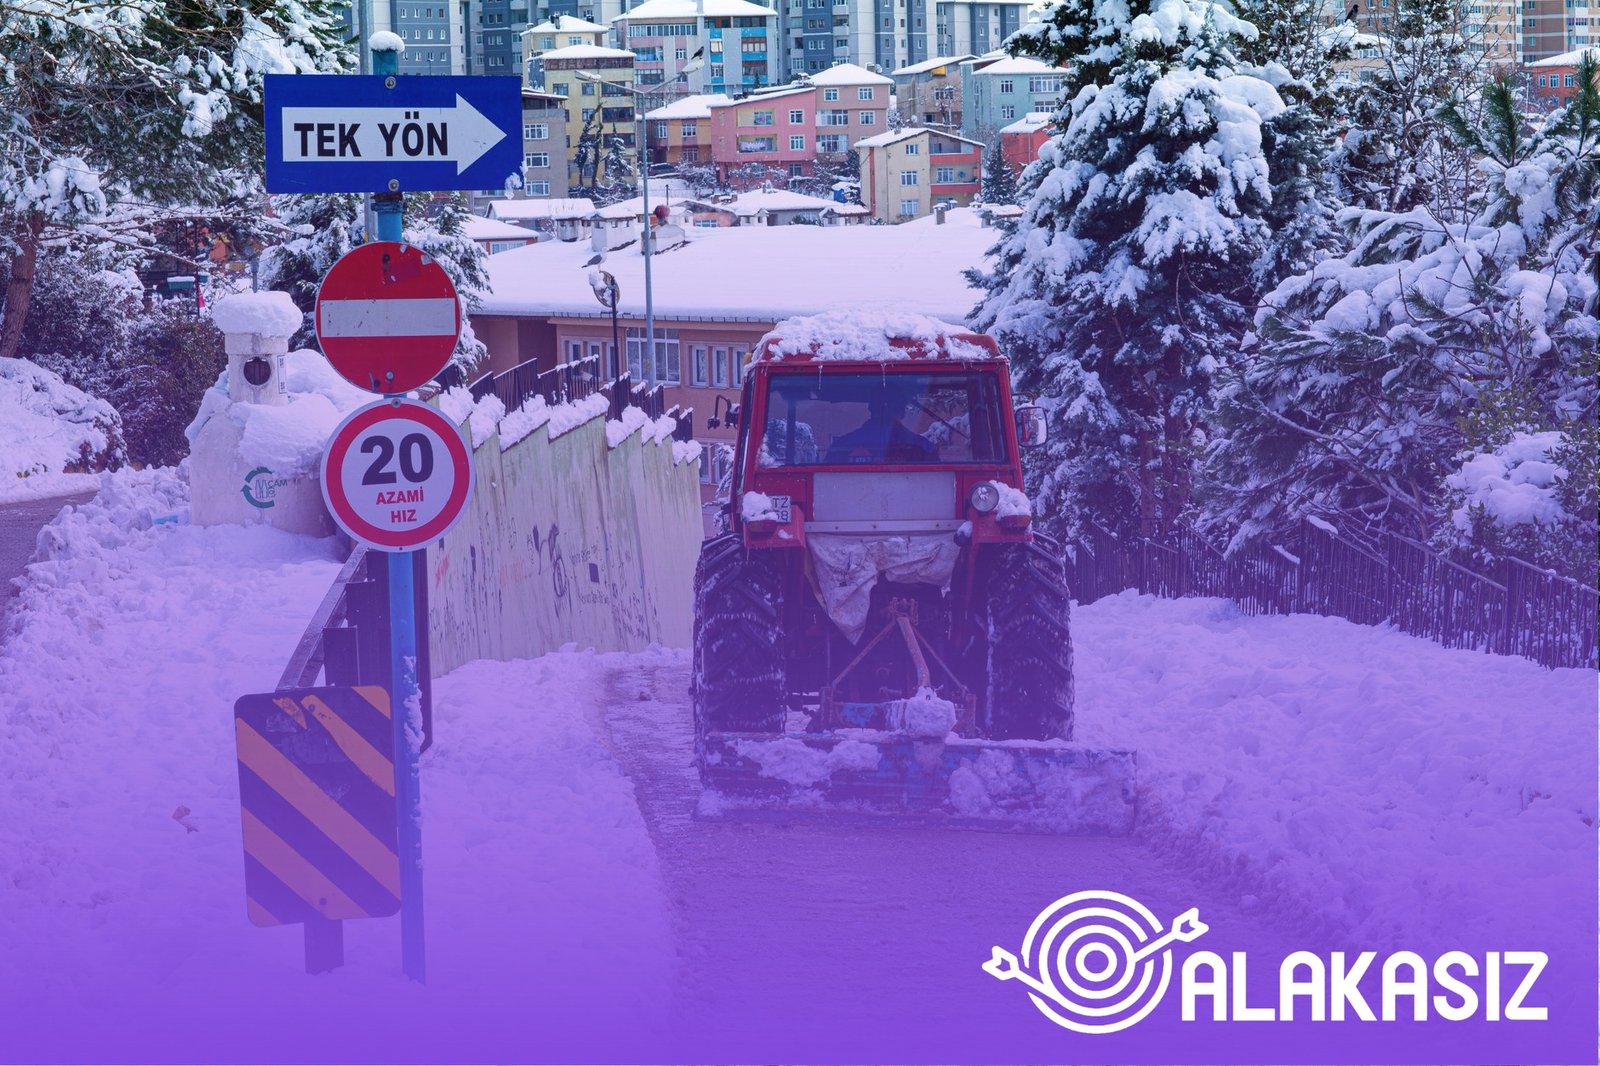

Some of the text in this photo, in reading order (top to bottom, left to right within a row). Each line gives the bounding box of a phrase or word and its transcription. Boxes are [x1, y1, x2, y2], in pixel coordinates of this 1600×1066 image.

[294, 111, 448, 157] TEK YÖN
[360, 433, 434, 486] 20
[376, 486, 424, 505] AZAMİ
[390, 509, 417, 523] HIZ
